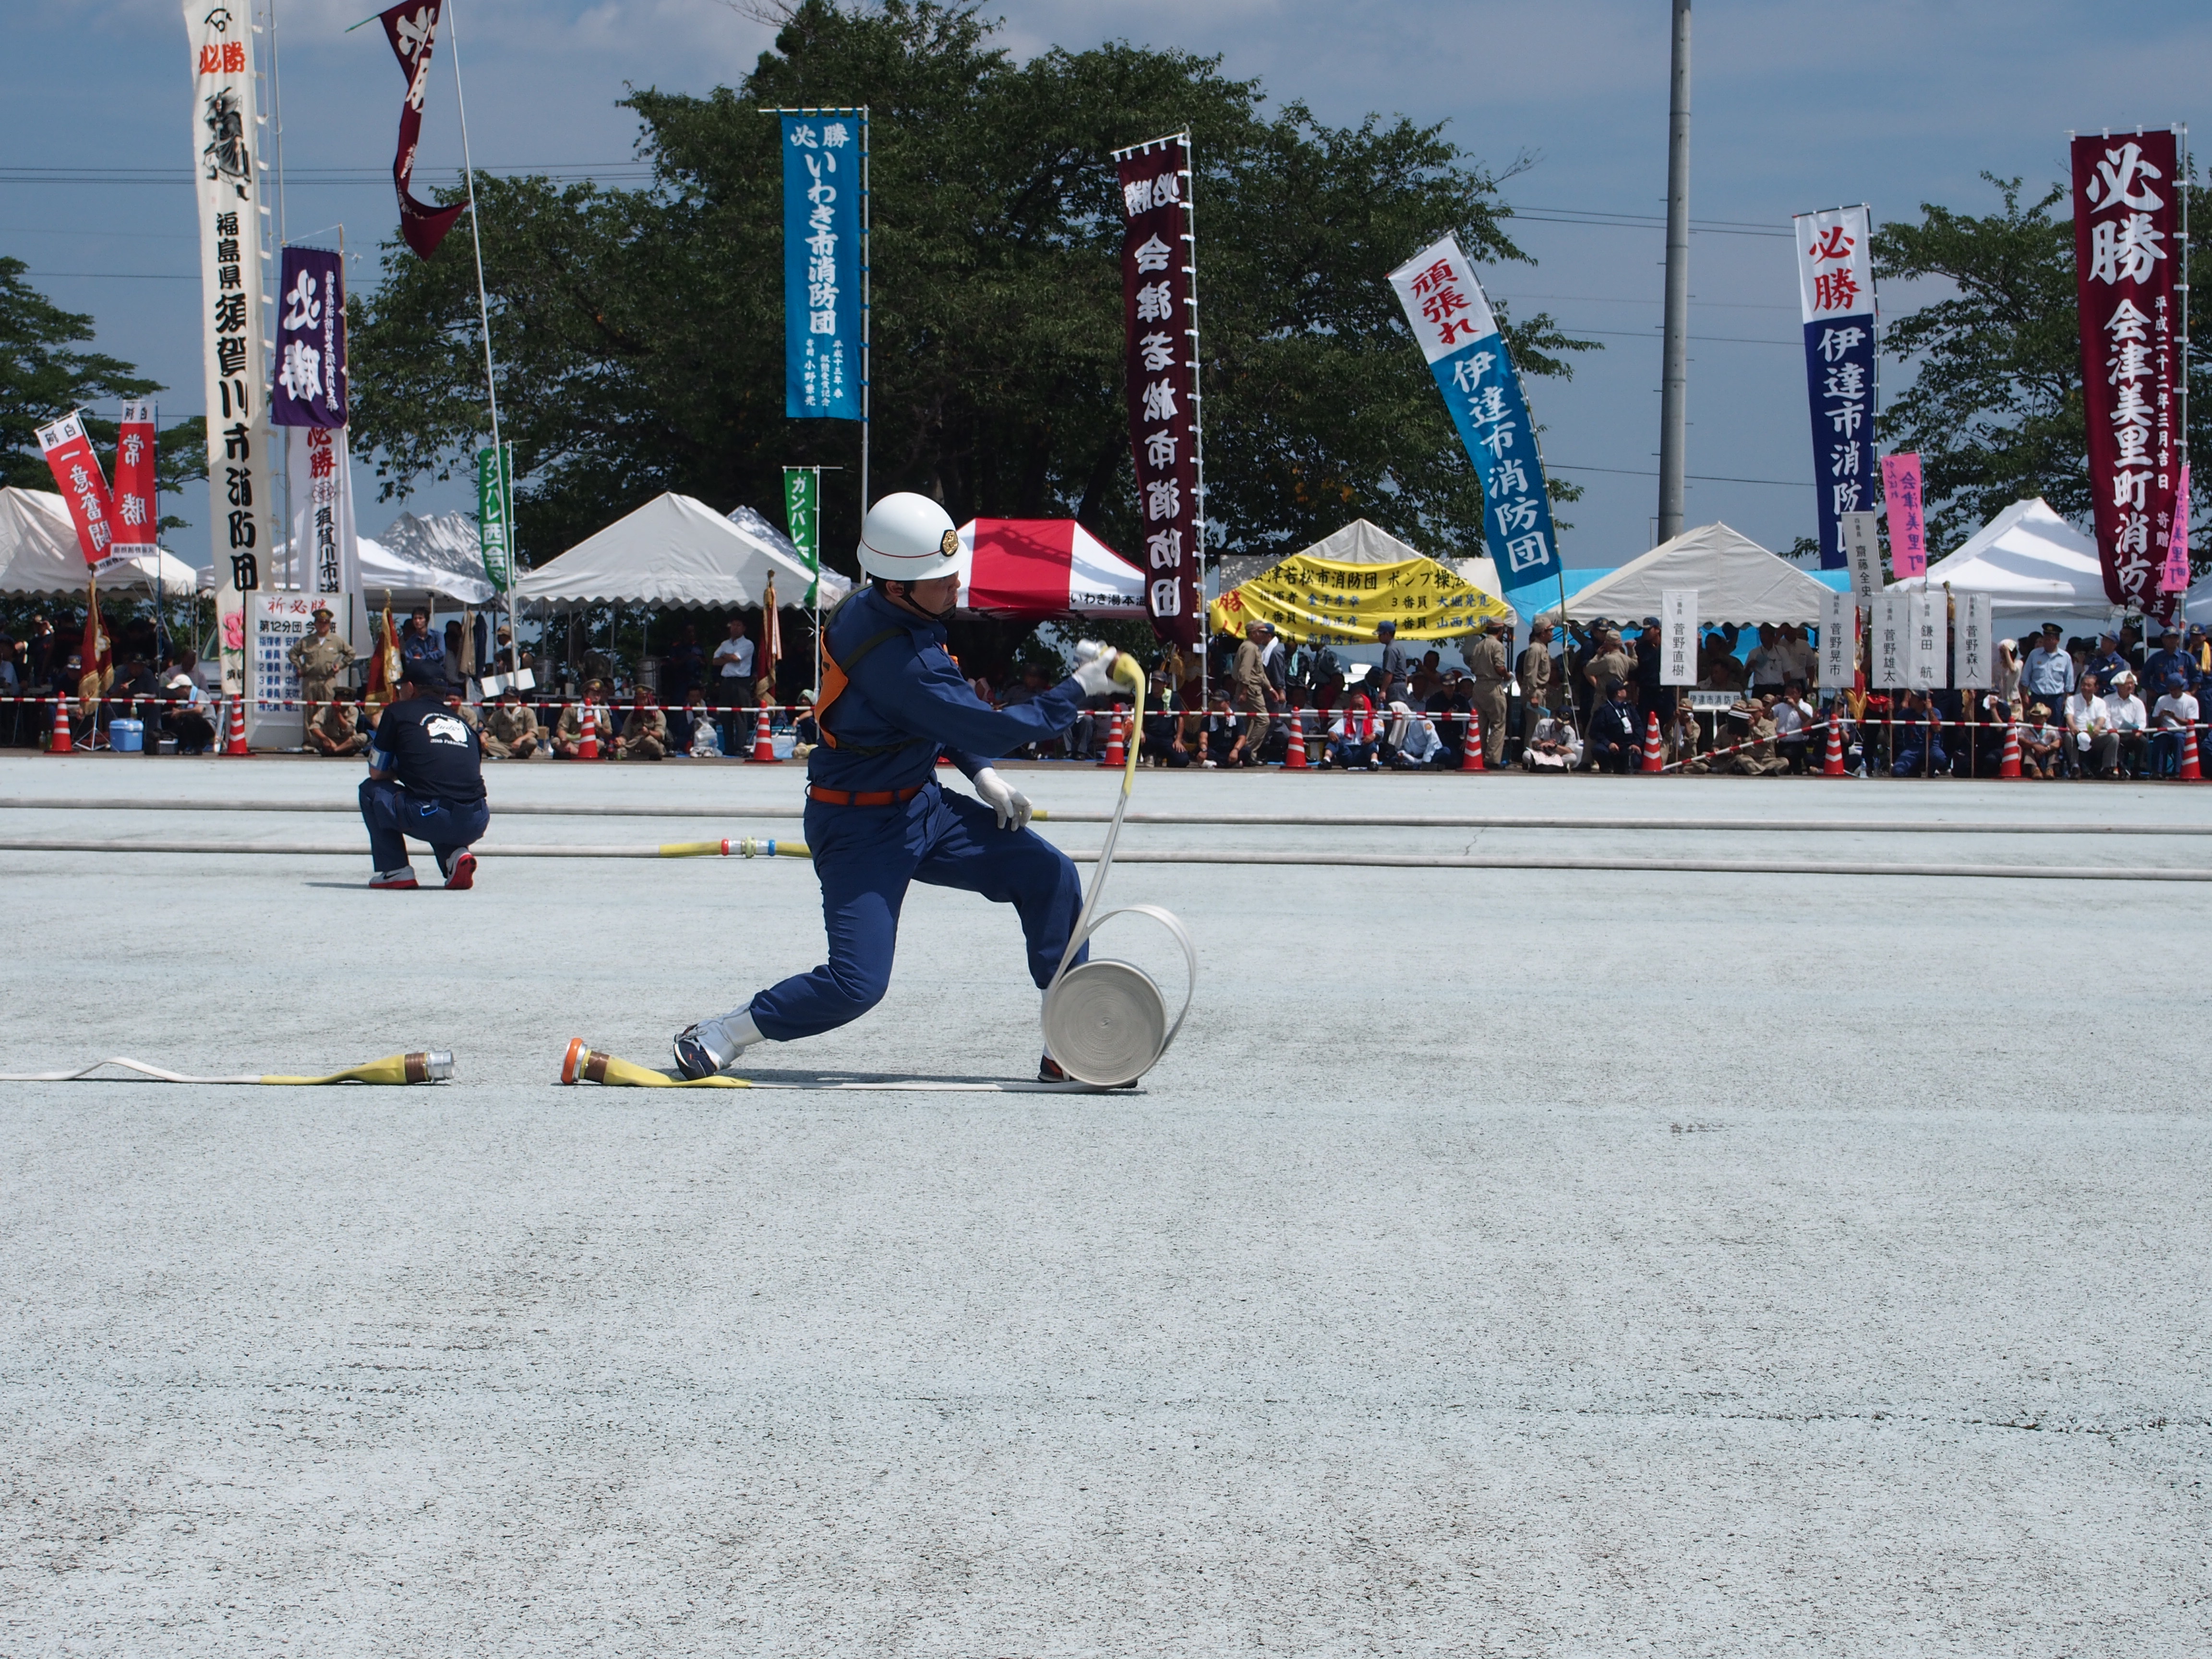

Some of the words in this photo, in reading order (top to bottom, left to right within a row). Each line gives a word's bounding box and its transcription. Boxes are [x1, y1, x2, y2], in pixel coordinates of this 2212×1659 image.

[200, 41, 246, 75] 必勝
[790, 122, 851, 148] 必勝
[2086, 142, 2167, 285] 必勝
[805, 151, 839, 336] いわき市消防団
[1808, 226, 1861, 312] 必勝
[1409, 257, 1480, 346] 頑張れ
[2154, 296, 2169, 490] 平成二十二年三月吉日
[308, 427, 337, 479] 必勝
[1452, 351, 1550, 574] 伊達市消防団
[2156, 512, 2169, 547] 寄贈
[1260, 590, 1298, 603] 指揮者
[260, 621, 301, 633] 第12分団
[1672, 623, 1685, 678] 菅野直樹
[1829, 623, 1841, 675] 菅野晃市
[1966, 625, 1978, 678] 菅野森人
[1883, 629, 1896, 683] 菅野雄太
